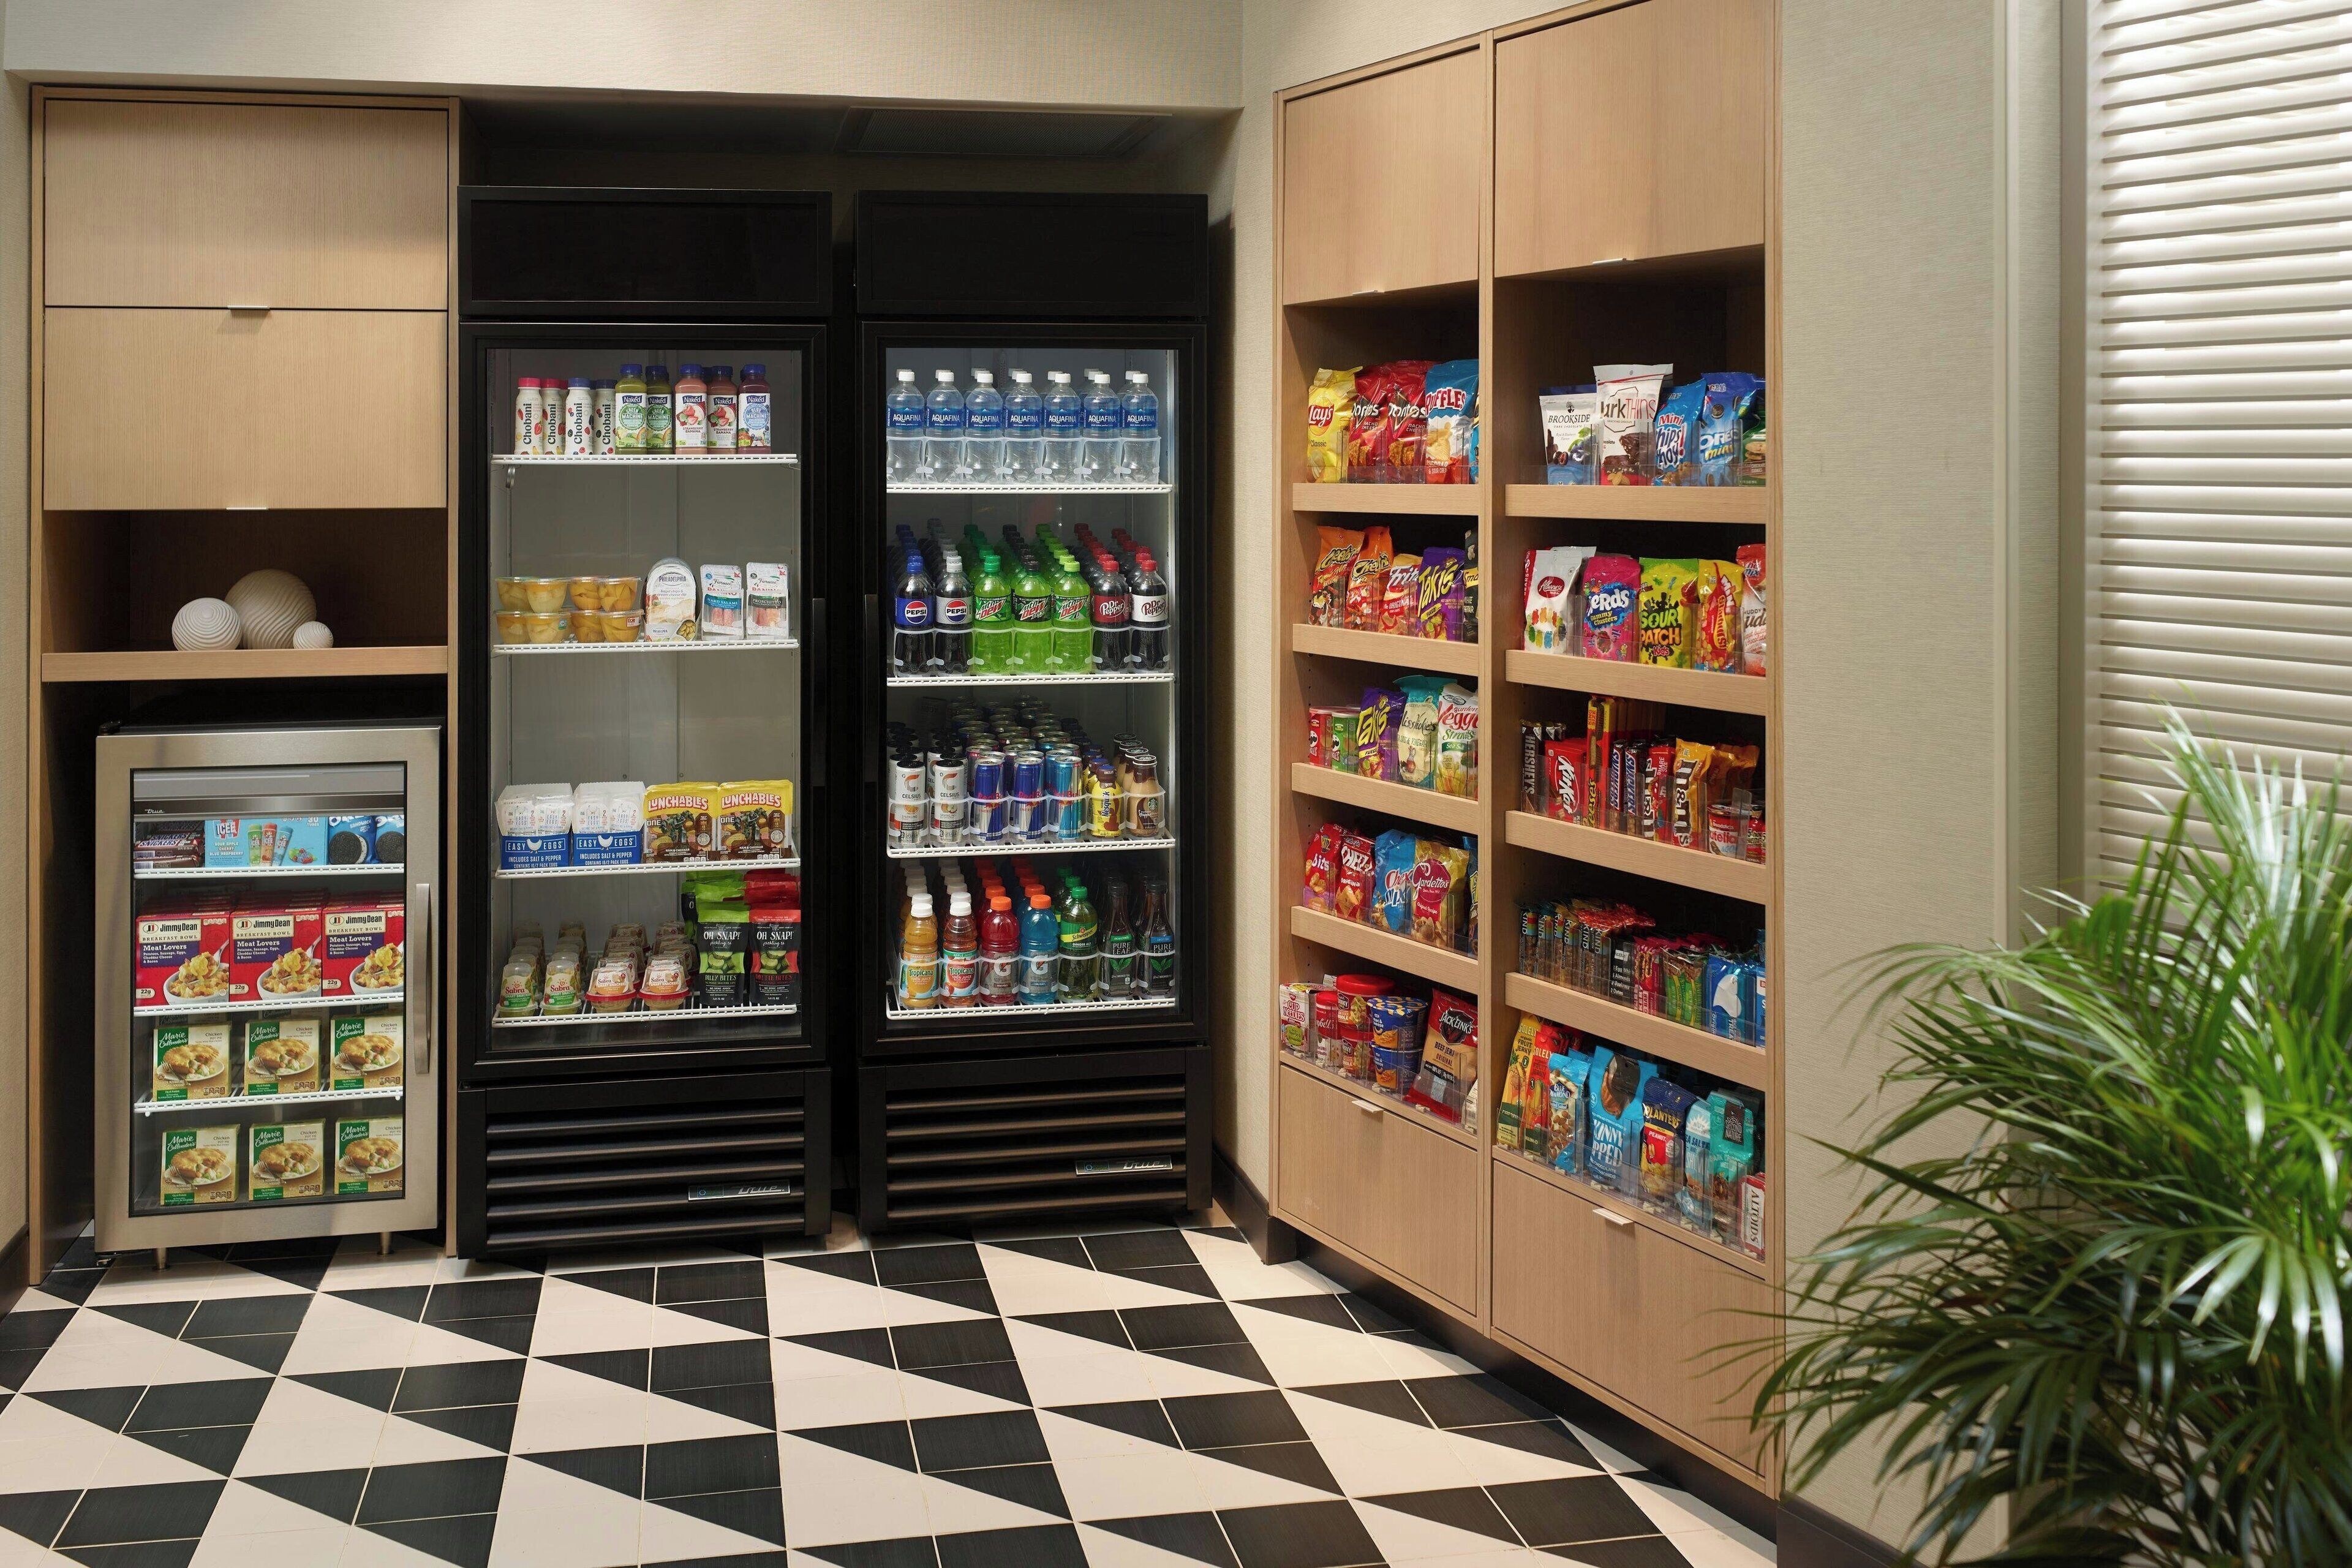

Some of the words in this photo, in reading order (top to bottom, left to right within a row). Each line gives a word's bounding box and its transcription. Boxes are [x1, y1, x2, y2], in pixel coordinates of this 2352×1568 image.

[1425, 388, 1466, 416] RUFFLES
[1388, 402, 1427, 418] Doritos
[892, 414, 921, 423] AQUAFINA
[932, 414, 960, 423] AQUAFINA
[971, 415, 999, 424] AQUAFINA
[1048, 415, 1077, 424] AQUAFINA
[1308, 407, 1334, 427] Lay's
[1548, 414, 1591, 424] BROOKSIDE
[1659, 414, 1684, 426] Mini
[523, 403, 532, 445] Chobani
[548, 404, 556, 445] Chobani
[574, 402, 582, 445] Chobani
[602, 404, 611, 445] Chobani
[1705, 444, 1733, 460] mini
[1388, 565, 1420, 588] Frito
[1539, 579, 1562, 593] Albanese
[1100, 602, 1125, 616] Pepper
[1141, 601, 1166, 616] Pepper
[1640, 609, 1679, 628] SOUR
[1640, 627, 1682, 646] PATCH
[1654, 646, 1670, 657] Kids
[1442, 729, 1475, 741] Straws
[1525, 736, 1536, 796] HERSHEY'S
[1558, 755, 1576, 815] KitKat
[648, 796, 709, 811] LUNCHABLES
[722, 793, 782, 809] LUNCHABLES
[1102, 790, 1110, 817] Nesquik
[216, 820, 236, 835] ICEE
[350, 820, 372, 829] SANDWICH
[507, 842, 526, 851] EASY
[543, 841, 562, 850] EGGS
[579, 838, 597, 848] EASY
[614, 837, 633, 846] EGGS
[1311, 853, 1330, 871] bits
[1412, 861, 1450, 902] Gardetto's
[160, 924, 182, 932] Jimmy
[254, 920, 275, 929] Jimmy
[1538, 915, 1547, 939] KIND
[704, 931, 714, 940] OH
[718, 931, 741, 940] SNAP!
[756, 931, 767, 940] OH
[770, 931, 793, 940] SNAP!
[1564, 919, 1573, 945] KIND
[1594, 927, 1603, 954] KIND
[908, 968, 933, 978] Tropicana
[505, 983, 525, 994] Sabra
[550, 982, 570, 992] Sabra
[1287, 1001, 1300, 1011] CUP
[1283, 1006, 1305, 1022] NOODLES
[1439, 1012, 1454, 1028] JACK
[251, 1027, 276, 1036] Marie
[337, 1023, 362, 1033] Marie
[1518, 1023, 1539, 1038] SOLELY
[160, 1032, 186, 1042] Marie
[251, 1032, 279, 1042] Callender's
[336, 1029, 364, 1039] Callender's
[159, 1038, 188, 1049] Callender's
[1518, 1038, 1532, 1049] FRUIT
[1515, 1045, 1532, 1055] JERKY
[1435, 1053, 1453, 1067] ORIGINAL
[1553, 1083, 1566, 1093] BLUE
[1644, 1105, 1681, 1129] PLANTERS
[342, 1125, 367, 1135] Marie
[168, 1135, 194, 1145] Marie
[255, 1131, 281, 1141] Marie
[341, 1132, 368, 1142] Callender's
[1648, 1131, 1667, 1141] PEANUT
[167, 1142, 196, 1152] Callender's
[255, 1137, 284, 1148] Callender's
[1750, 1189, 1760, 1243] ALTOIDS
